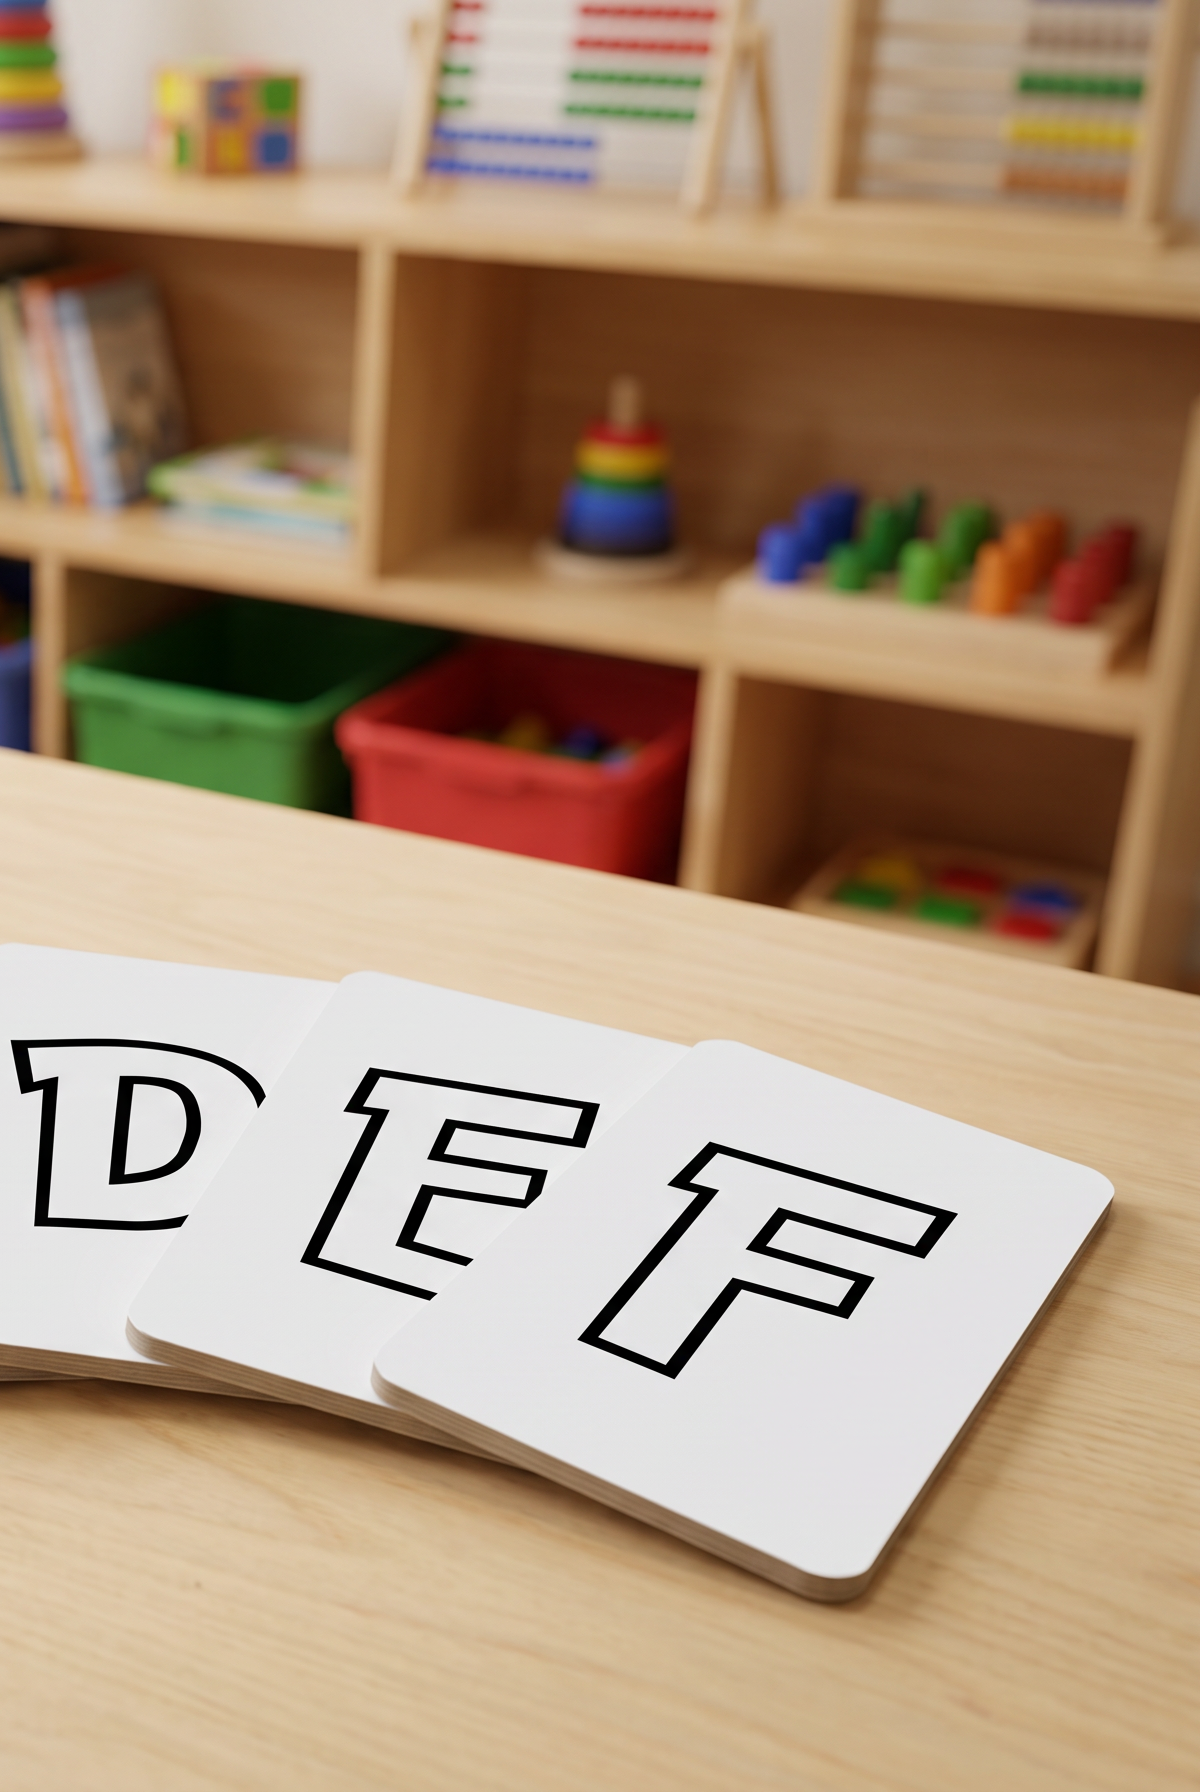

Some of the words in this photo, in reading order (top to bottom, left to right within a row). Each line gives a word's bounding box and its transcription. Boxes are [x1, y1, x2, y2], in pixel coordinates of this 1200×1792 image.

[10, 1039, 267, 1231] D
[299, 1067, 601, 1301] E
[577, 1141, 958, 1380] F
